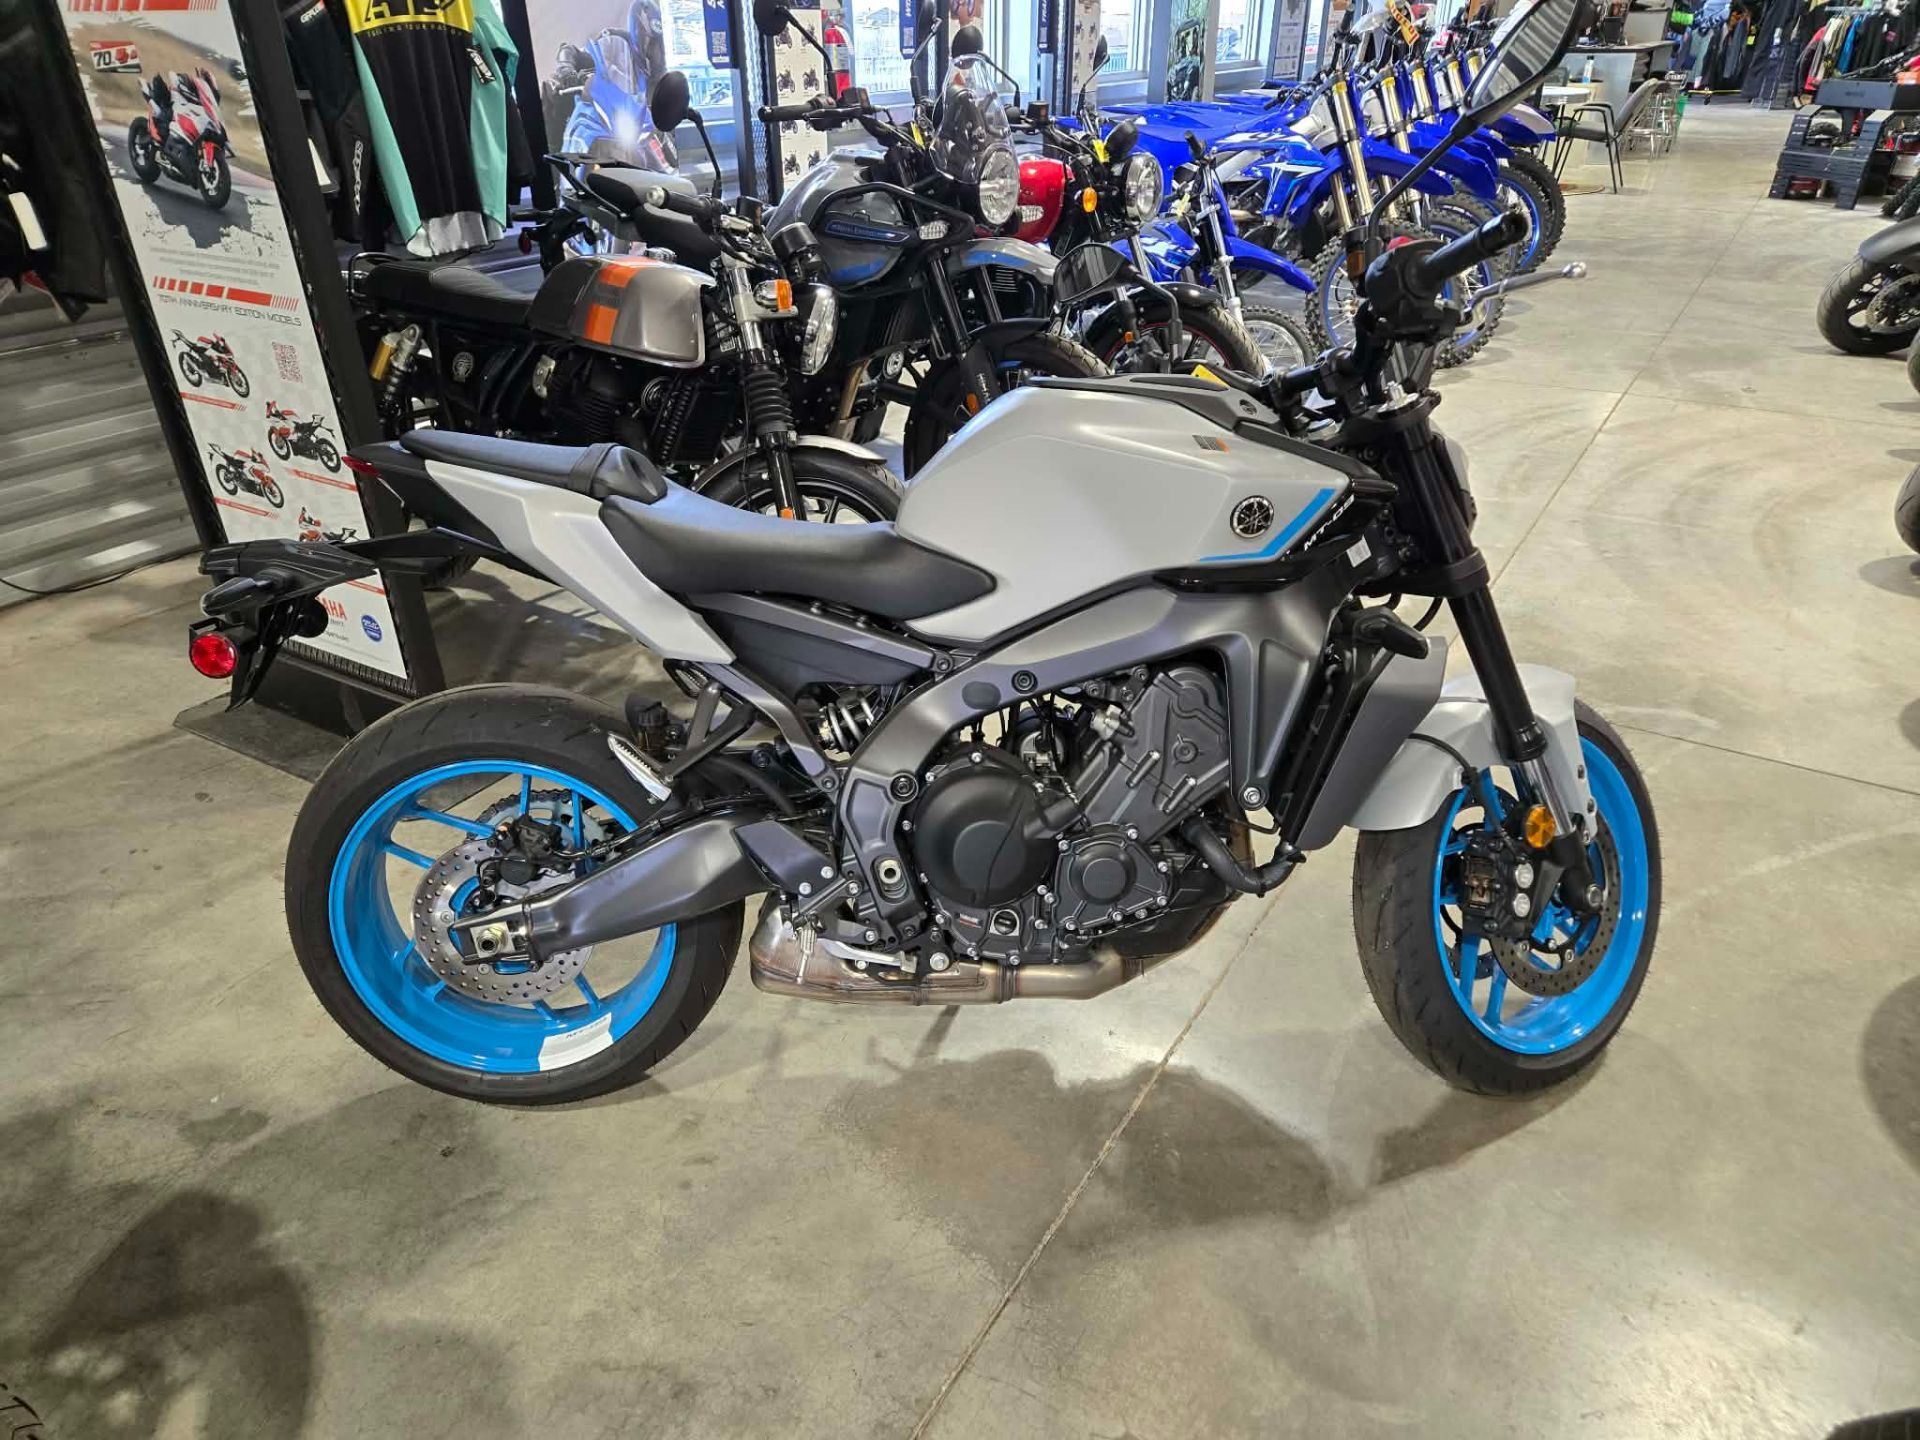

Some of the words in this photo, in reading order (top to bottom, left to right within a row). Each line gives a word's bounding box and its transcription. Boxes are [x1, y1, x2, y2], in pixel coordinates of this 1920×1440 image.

[93, 50, 112, 67] 70
[179, 297, 232, 314] ANNIVERSARY
[234, 306, 266, 321] EDITION
[266, 313, 302, 327] MODELS
[1303, 493, 1355, 552] MT-09
